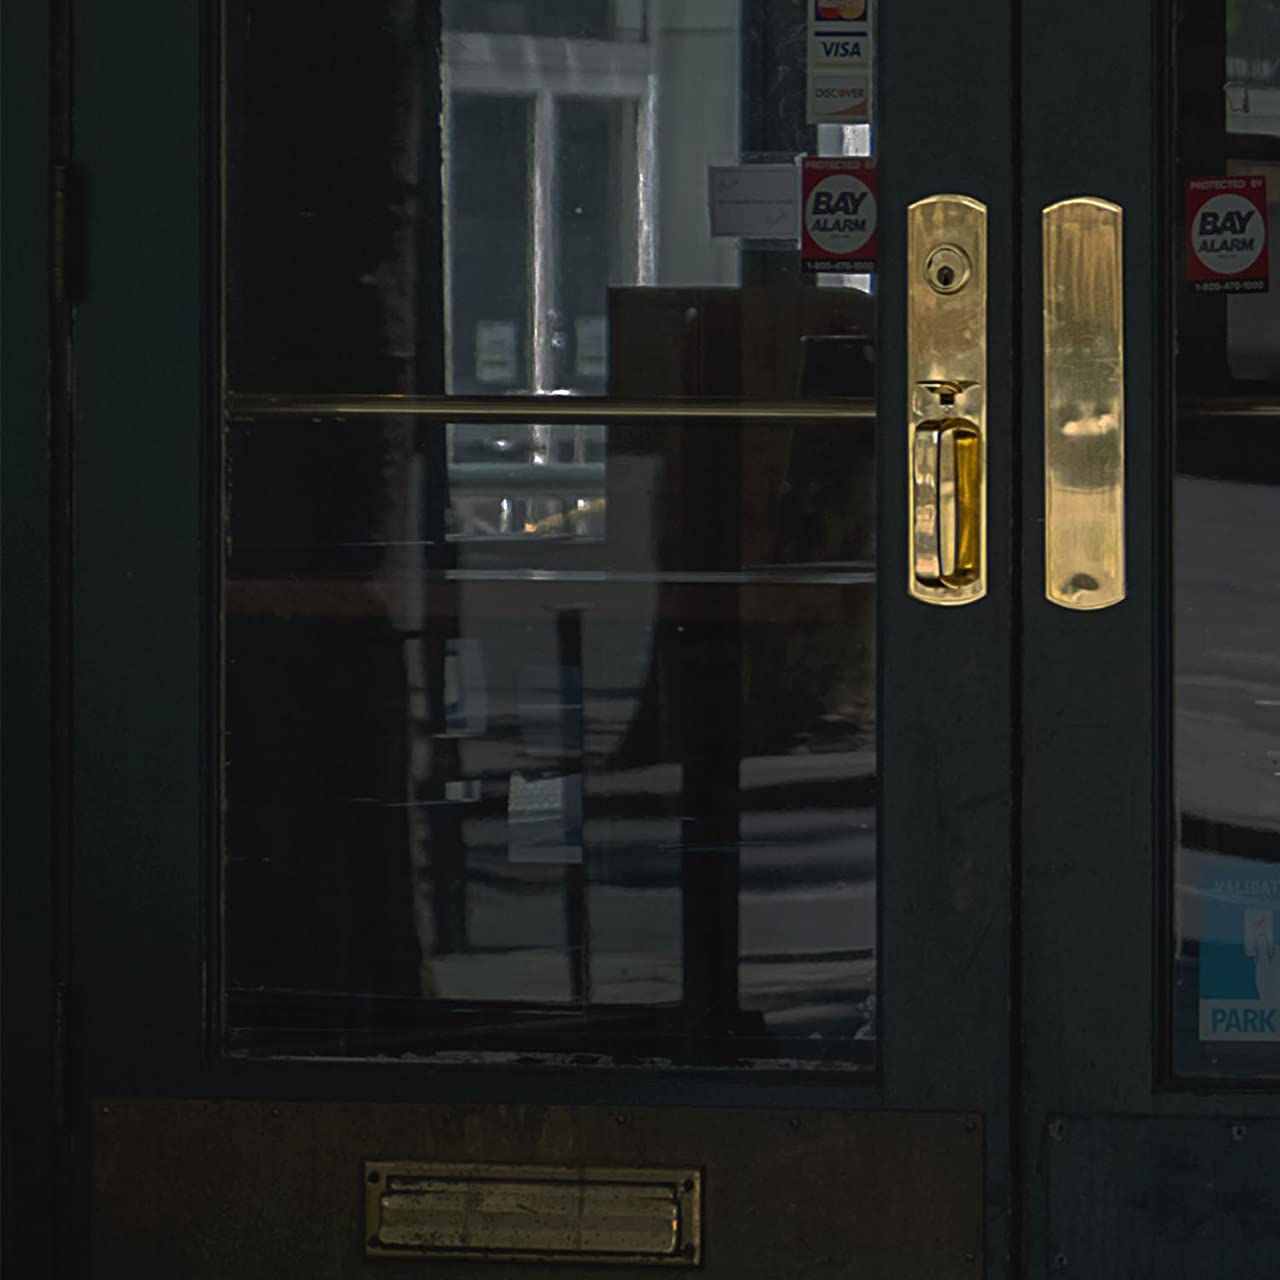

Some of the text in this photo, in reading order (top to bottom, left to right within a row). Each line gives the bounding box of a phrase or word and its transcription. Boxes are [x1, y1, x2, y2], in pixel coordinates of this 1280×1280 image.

[821, 41, 862, 57] VISA
[812, 191, 868, 216] BAY
[810, 217, 867, 233] ALARM
[1199, 210, 1256, 236] BAY
[1198, 237, 1255, 253] ALARM
[1211, 1007, 1276, 1033] PARK
